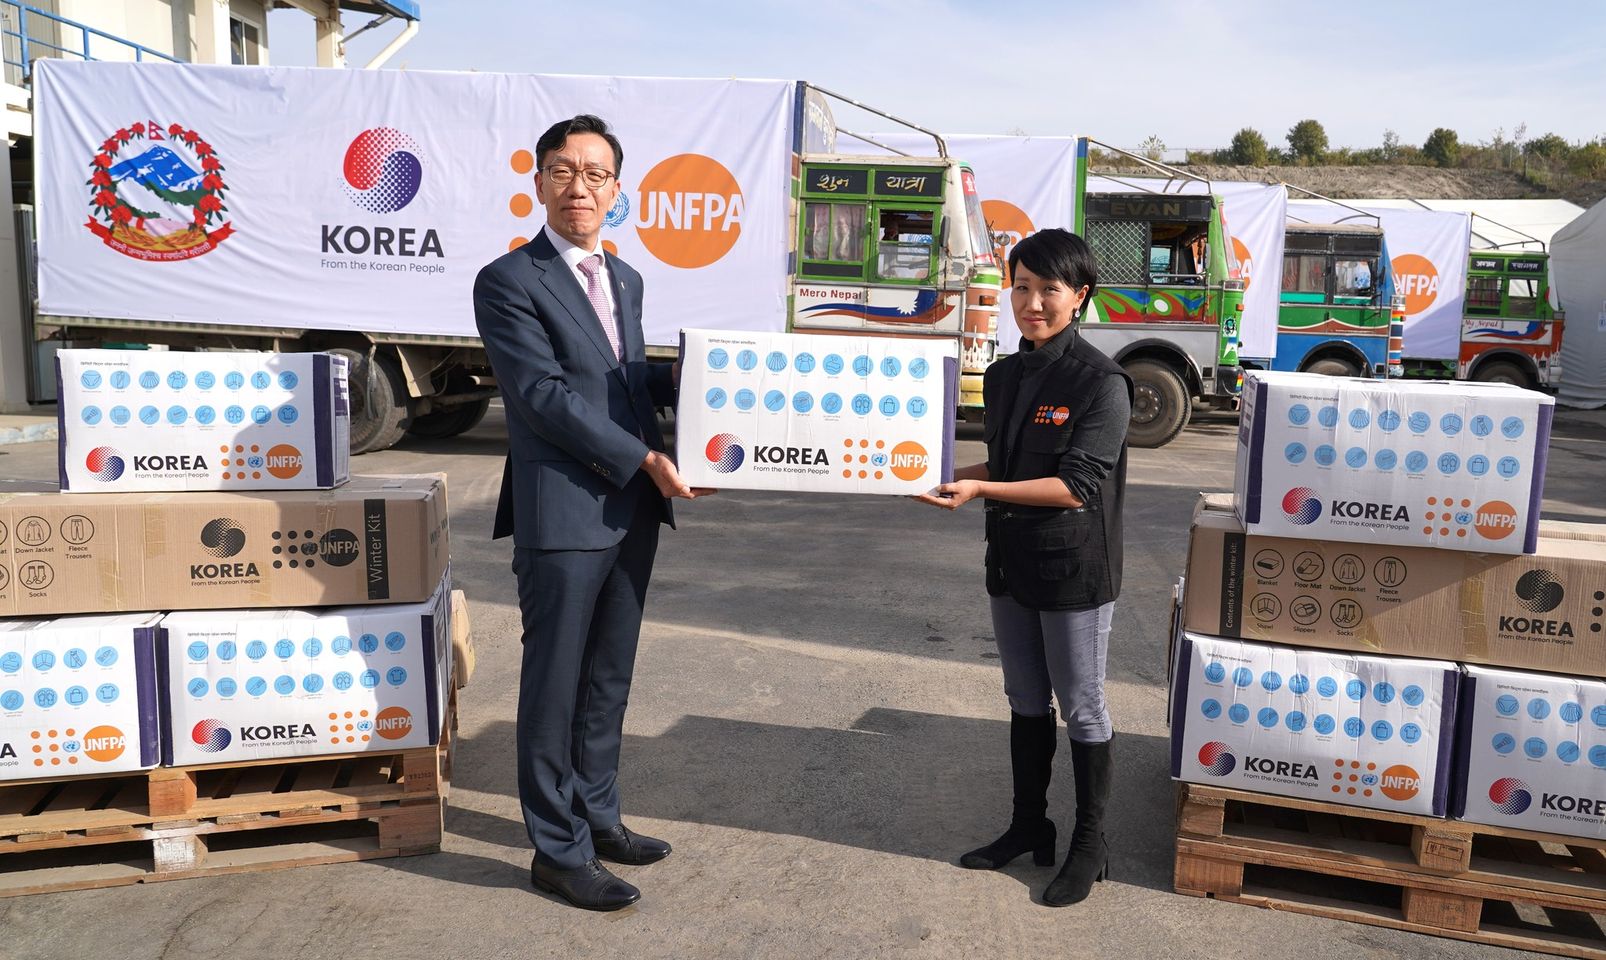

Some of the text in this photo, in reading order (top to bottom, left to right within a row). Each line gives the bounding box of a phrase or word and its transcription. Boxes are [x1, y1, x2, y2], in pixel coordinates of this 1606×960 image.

[635, 190, 746, 232] UNFPA
[1110, 201, 1181, 216] EVAN
[321, 224, 445, 258] KOREA
[321, 259, 445, 275] From the Korean People
[1393, 272, 1439, 297] NFPA
[799, 287, 862, 301] Mero Nepal
[133, 455, 208, 471] KOREA
[265, 455, 304, 468] UNFPA
[754, 445, 830, 466] KOREA
[889, 452, 929, 469] UNFPA
[164, 471, 187, 479] Korean
[188, 472, 210, 480] People
[808, 468, 830, 476] People
[1331, 500, 1410, 522] KOREA
[1348, 519, 1360, 527] the
[1361, 521, 1385, 529] Korean
[1386, 523, 1410, 531] People
[1474, 512, 1518, 529] UNFPA
[319, 540, 360, 555] UNFPA
[368, 513, 383, 583] Winter Kit
[191, 562, 260, 579] KOREA
[1229, 556, 1237, 576] winter
[240, 578, 261, 586] People
[1228, 578, 1236, 589] the
[1257, 578, 1278, 586] Blanket
[1329, 584, 1346, 592] Down
[1376, 595, 1402, 603] Trousers
[1225, 600, 1235, 629] Contents
[1293, 626, 1316, 634] Slippers
[1336, 629, 1353, 637] Socks
[1499, 615, 1574, 637] KOREA
[1527, 635, 1551, 643] Korean
[1551, 637, 1574, 646] People
[374, 716, 413, 731] UNFPA
[240, 723, 316, 741] KOREA
[83, 735, 126, 752] UNFPA
[296, 738, 318, 747] People
[1244, 755, 1319, 781] KOREA
[1243, 772, 1319, 788] From the Korean People
[1381, 774, 1421, 790] UNFPA
[1541, 793, 1606, 817] KORE
[1540, 810, 1558, 819] From
[1559, 812, 1571, 821] the
[1573, 815, 1599, 824] Korean
